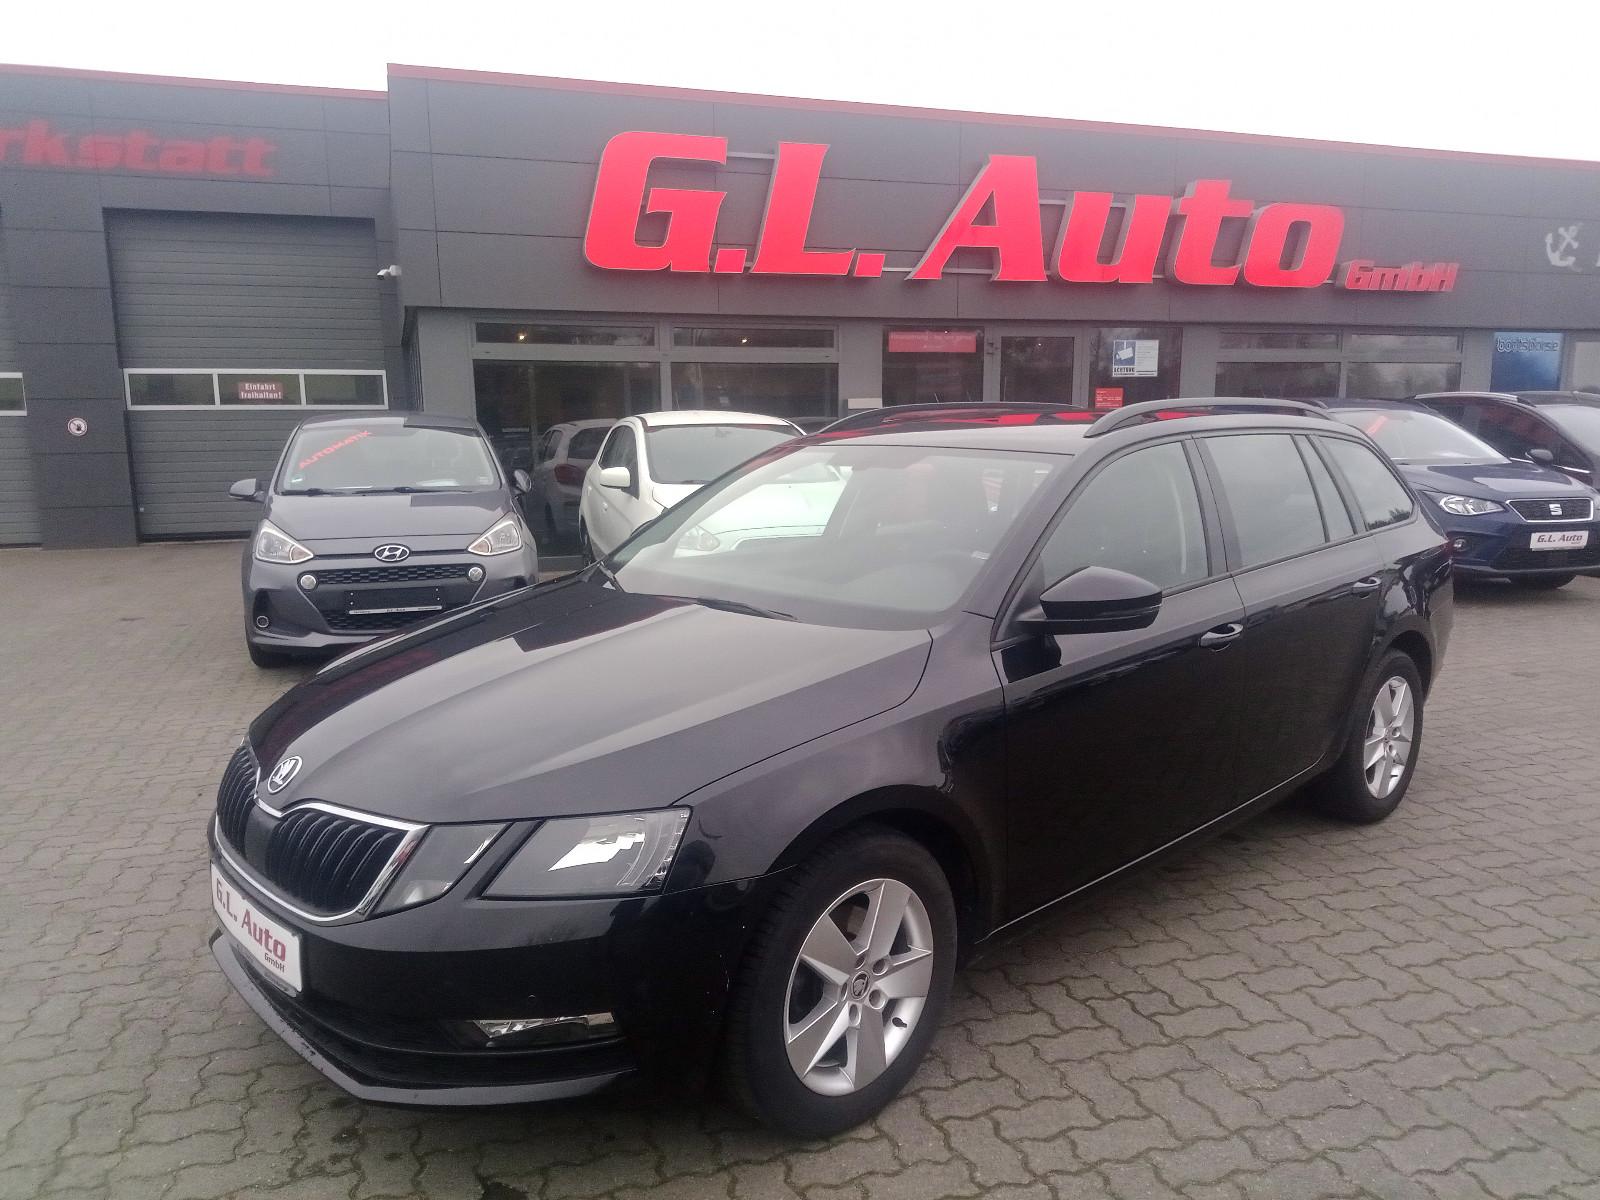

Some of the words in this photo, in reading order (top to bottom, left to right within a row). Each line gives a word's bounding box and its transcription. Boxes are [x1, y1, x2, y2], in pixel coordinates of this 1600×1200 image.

[583, 130, 886, 278] G.L.
[905, 154, 1346, 289] Auto
[1345, 259, 1459, 292] GmbH
[245, 383, 276, 391] Einfahrt
[1557, 533, 1583, 542] Auto
[216, 878, 238, 922] G.L.
[241, 907, 286, 961] Auto
[264, 951, 285, 973] GmbH
